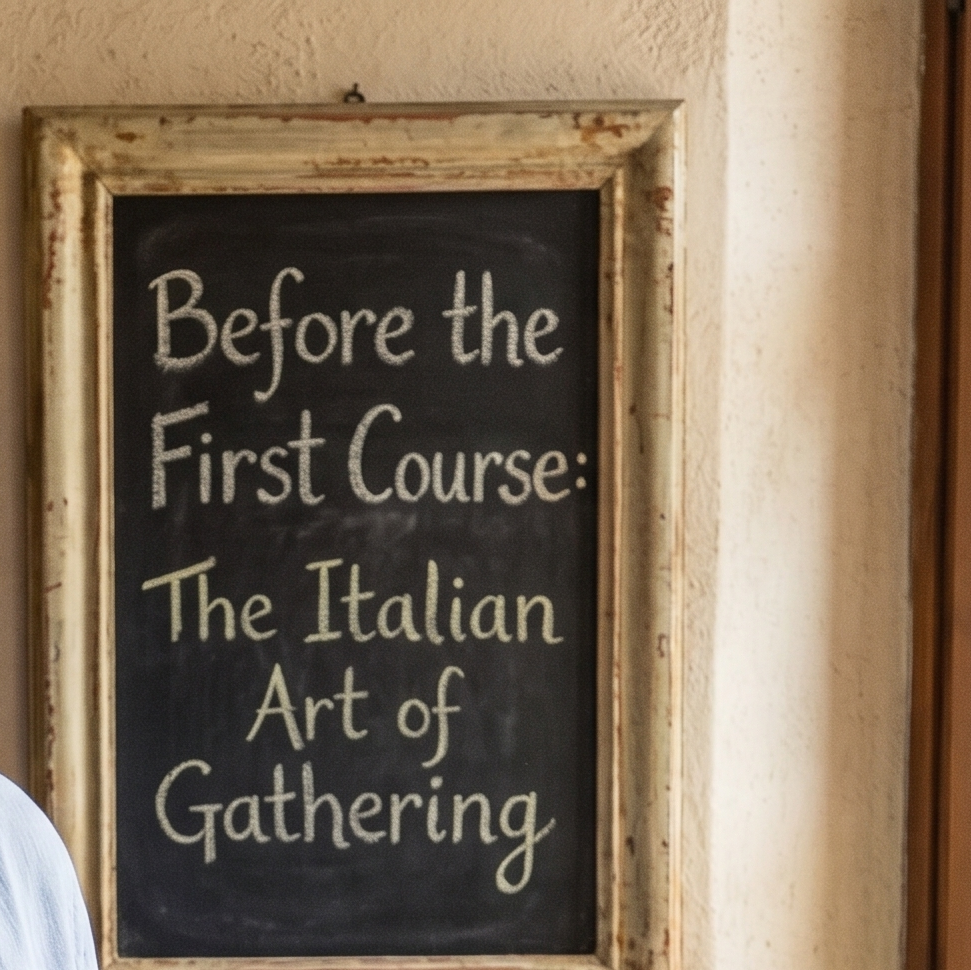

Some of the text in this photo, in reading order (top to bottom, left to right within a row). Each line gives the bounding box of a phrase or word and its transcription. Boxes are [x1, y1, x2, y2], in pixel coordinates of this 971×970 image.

[148, 267, 564, 402] Before the
[151, 402, 588, 509] First Course:
[141, 556, 564, 645] The Italian
[245, 663, 465, 768] Art of
[155, 759, 556, 895] Gathering
